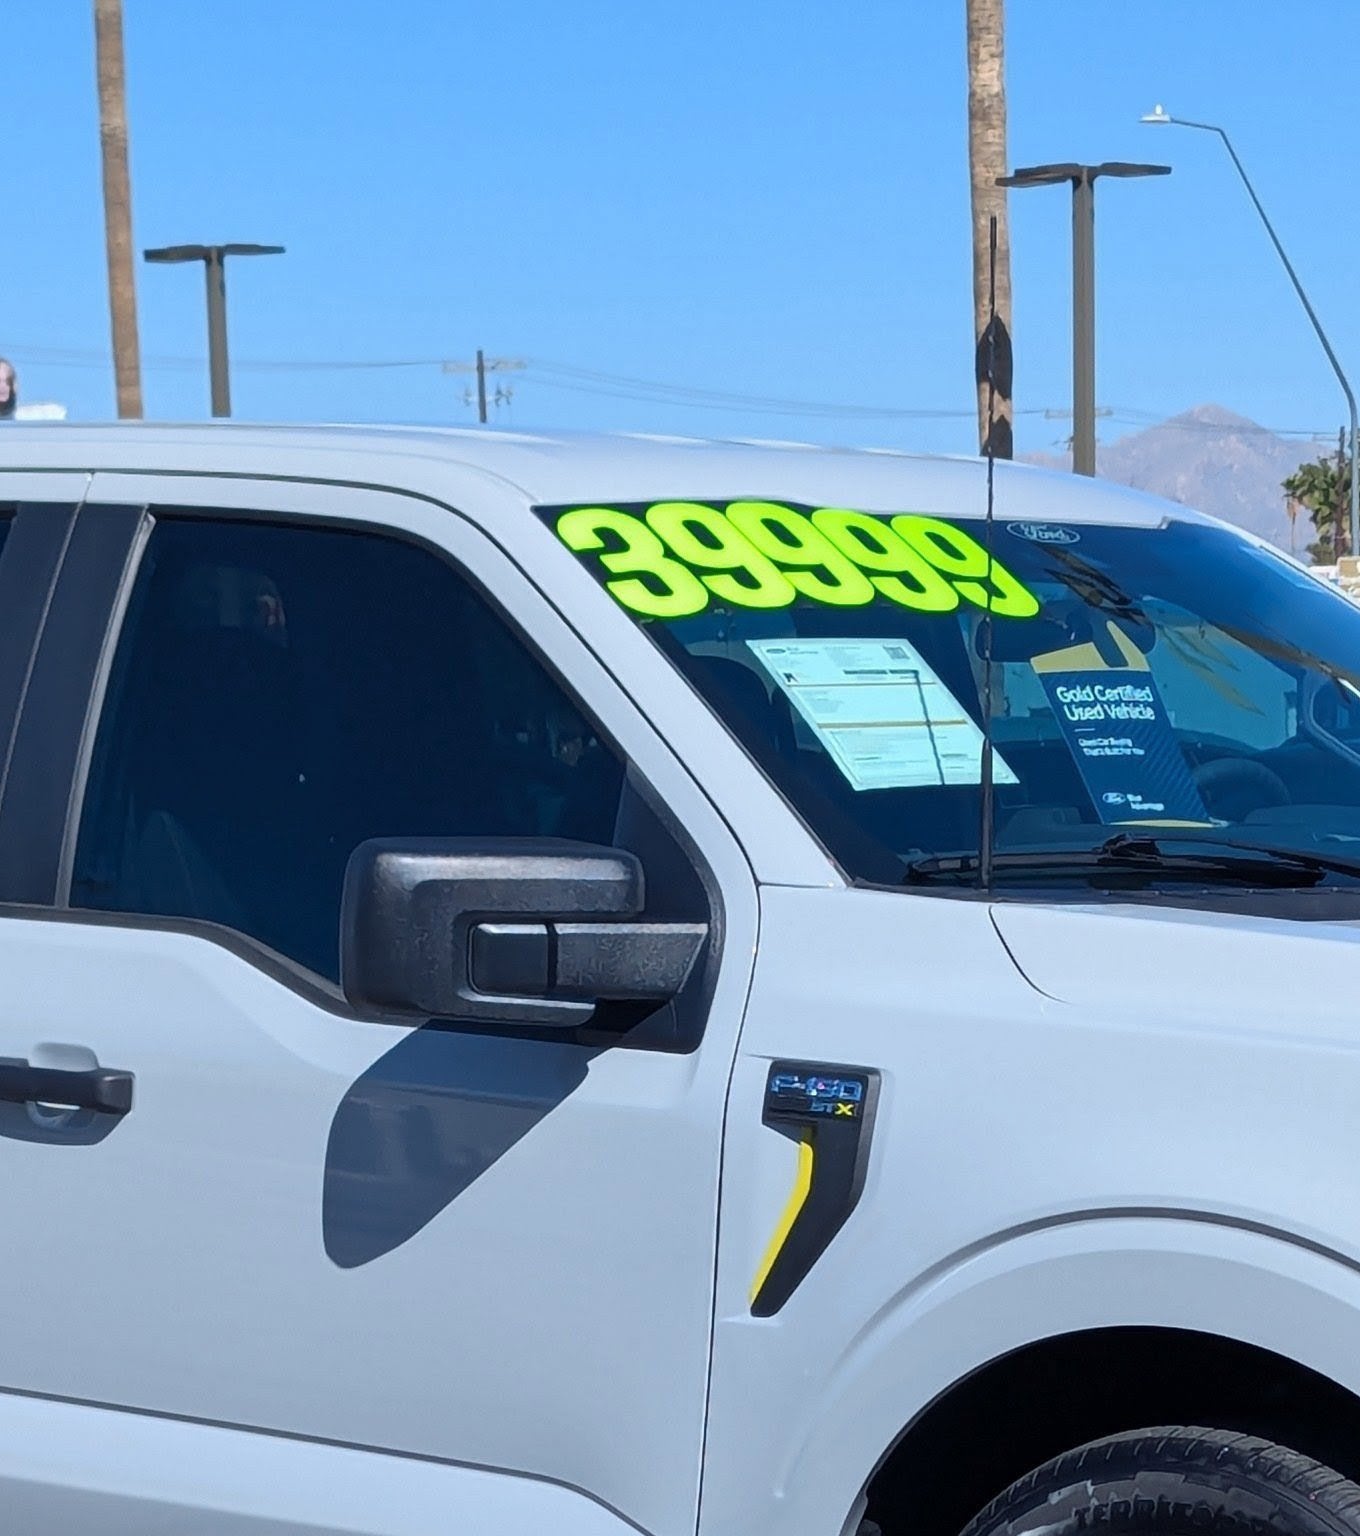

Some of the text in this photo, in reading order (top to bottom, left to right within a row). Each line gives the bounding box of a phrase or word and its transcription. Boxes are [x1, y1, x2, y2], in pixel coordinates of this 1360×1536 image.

[556, 500, 1040, 618] 39999
[1055, 684, 1154, 703] Gold Certified
[1063, 702, 1156, 721] Used Vehicle
